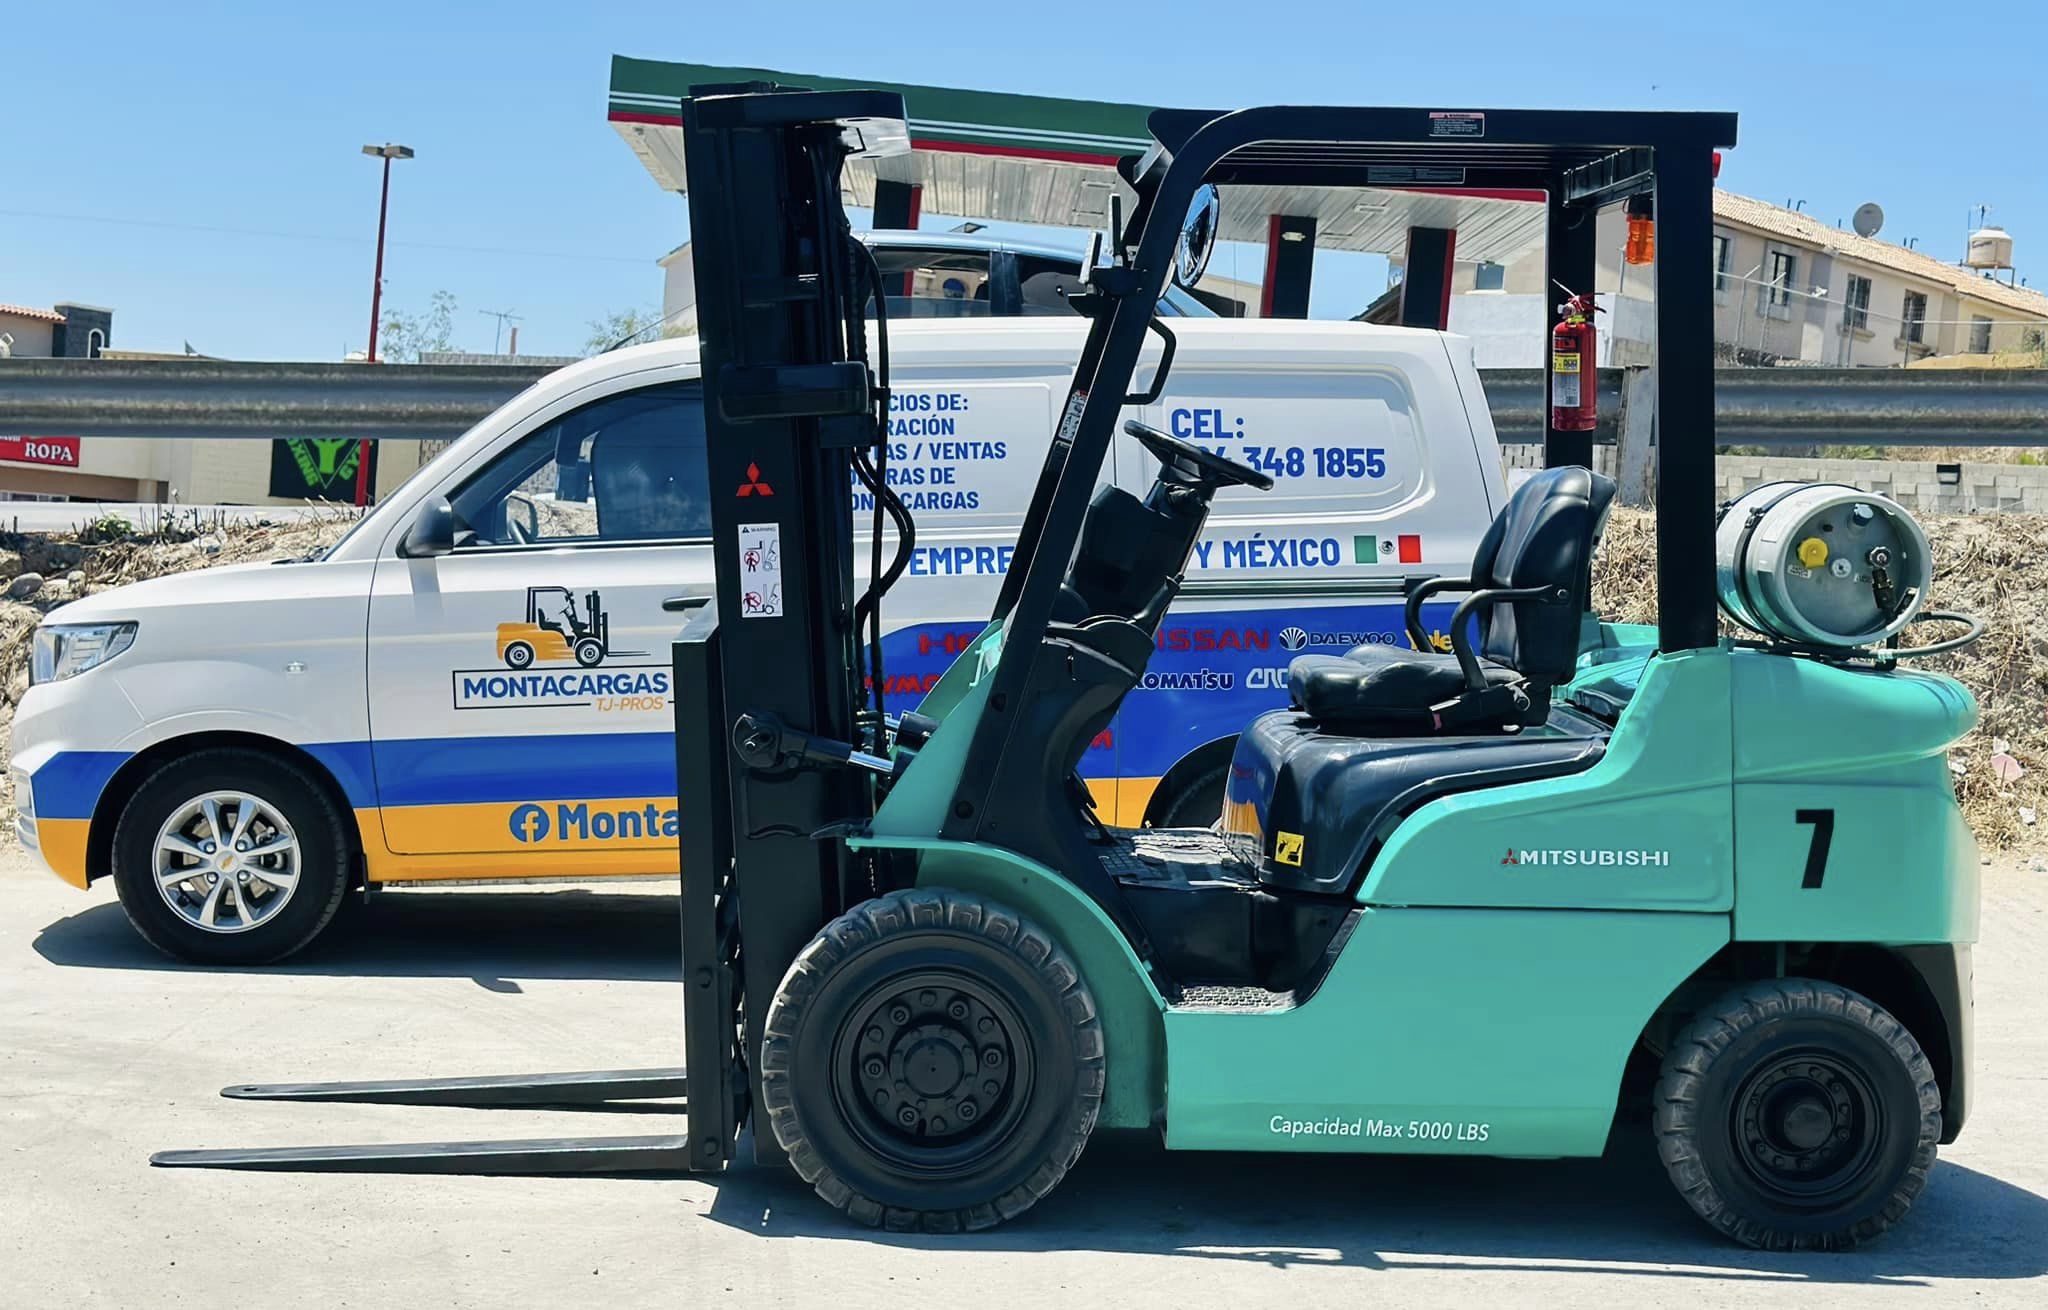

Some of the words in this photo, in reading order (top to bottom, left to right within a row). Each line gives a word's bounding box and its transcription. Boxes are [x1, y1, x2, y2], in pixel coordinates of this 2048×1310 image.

[936, 394, 968, 411] DE:
[1171, 408, 1245, 439] CEL:
[25, 442, 73, 461] ROPA
[929, 442, 1007, 460] VENTAS
[1243, 446, 1304, 478] 348
[1313, 448, 1386, 478] 1855
[930, 467, 955, 485] DE
[910, 546, 1015, 575] EMPRE
[1195, 541, 1213, 568] Y
[1223, 532, 1340, 568] MÉXICO
[1309, 632, 1397, 646] DAEWOO
[463, 672, 669, 699] MONTACARGAS
[1136, 668, 1234, 690] OMATSU
[597, 696, 664, 712] TJ-PROS
[557, 803, 680, 840] Monta
[1520, 850, 1669, 865] MITSUBISHI
[1795, 808, 1834, 889] 7
[1270, 1115, 1362, 1138] Capacidad
[1366, 1119, 1403, 1138] Max
[1407, 1121, 1453, 1140] 5000
[1457, 1123, 1489, 1142] LBS
